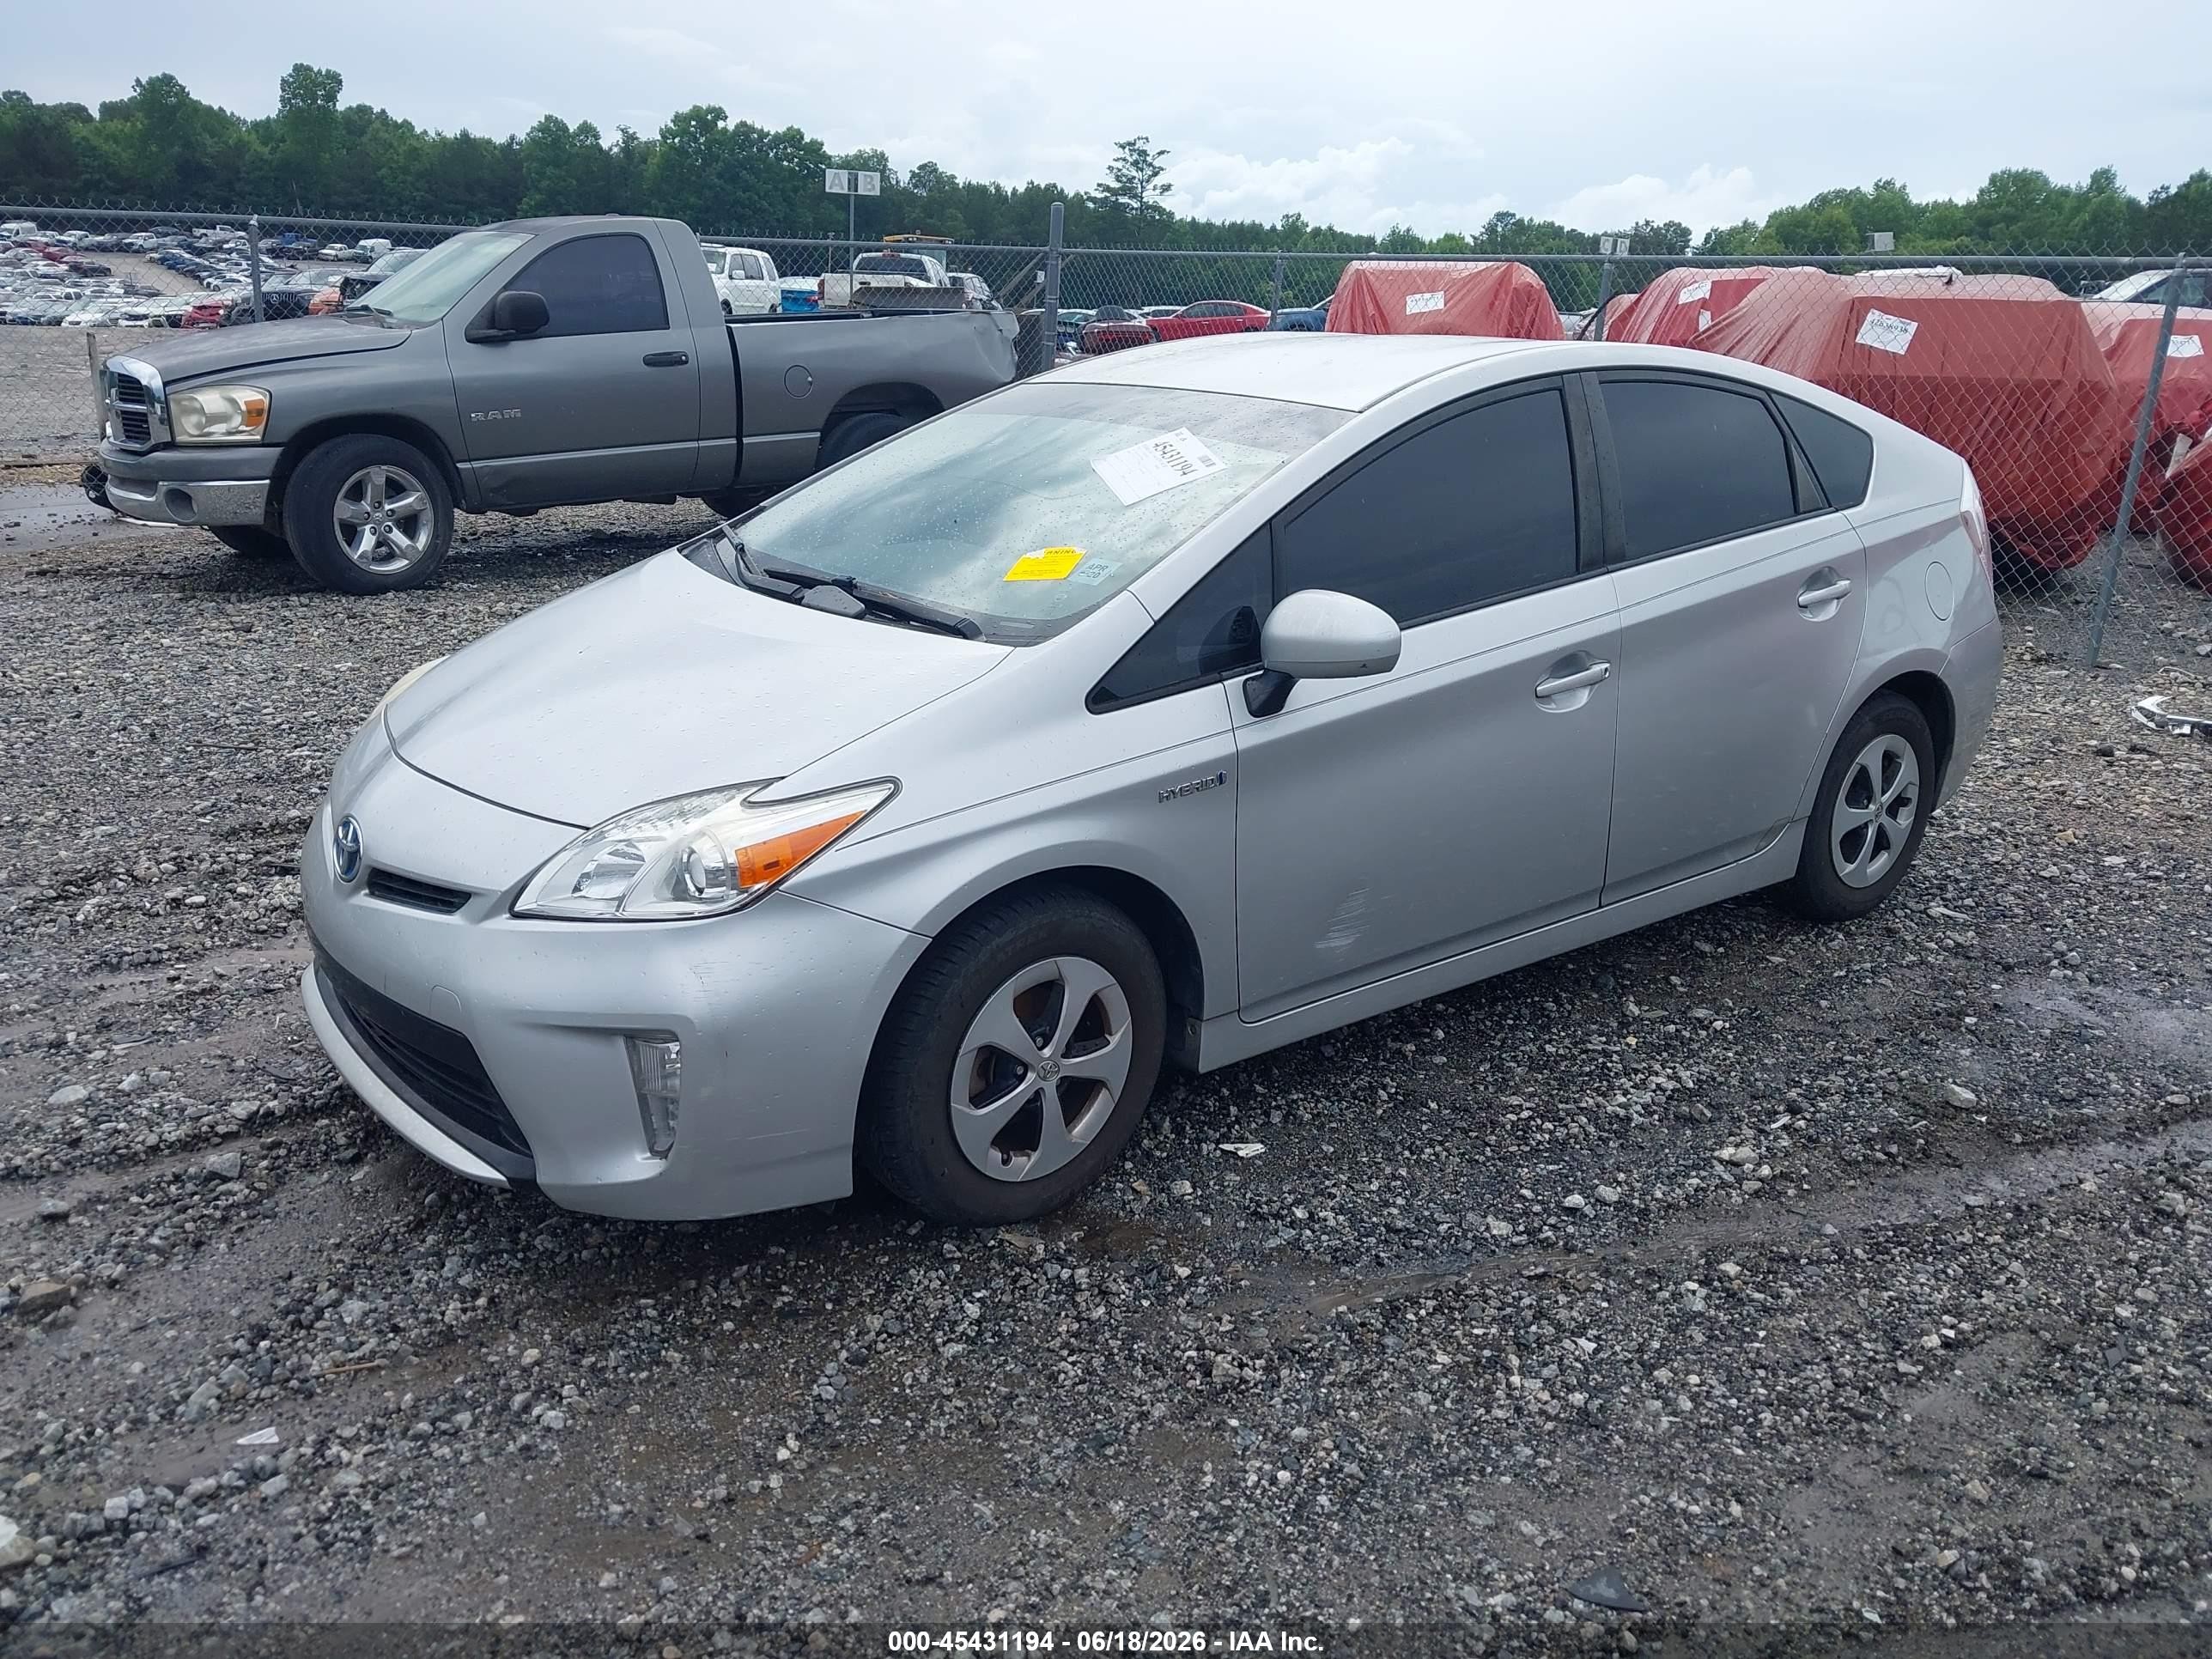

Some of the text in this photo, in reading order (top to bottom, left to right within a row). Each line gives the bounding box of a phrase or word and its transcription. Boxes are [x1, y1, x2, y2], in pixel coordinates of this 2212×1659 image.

[829, 172, 876, 192] A B
[471, 409, 522, 422] RAM
[1152, 441, 1199, 477] 45431194
[1085, 562, 1109, 572] APR
[1158, 776, 1218, 803] HYBRID
